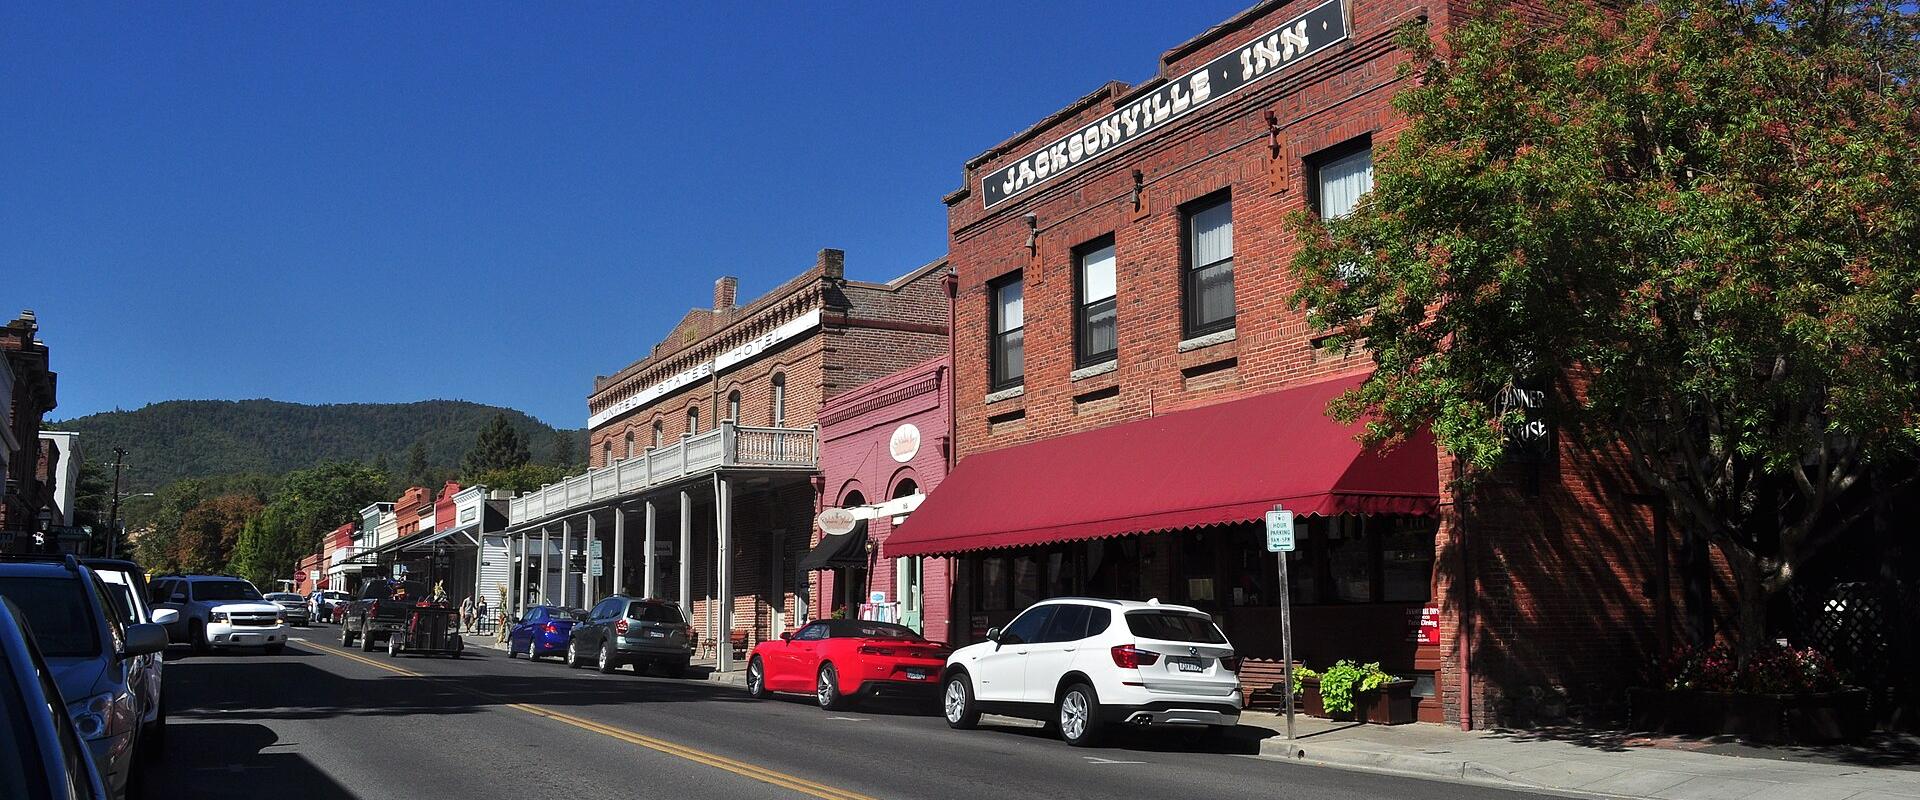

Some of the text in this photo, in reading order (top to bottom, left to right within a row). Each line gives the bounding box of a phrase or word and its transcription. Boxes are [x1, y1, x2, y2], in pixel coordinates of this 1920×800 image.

[1002, 18, 1310, 196] JACKSONVILLE INN
[602, 333, 784, 421] UNITED STATES HOTEL
